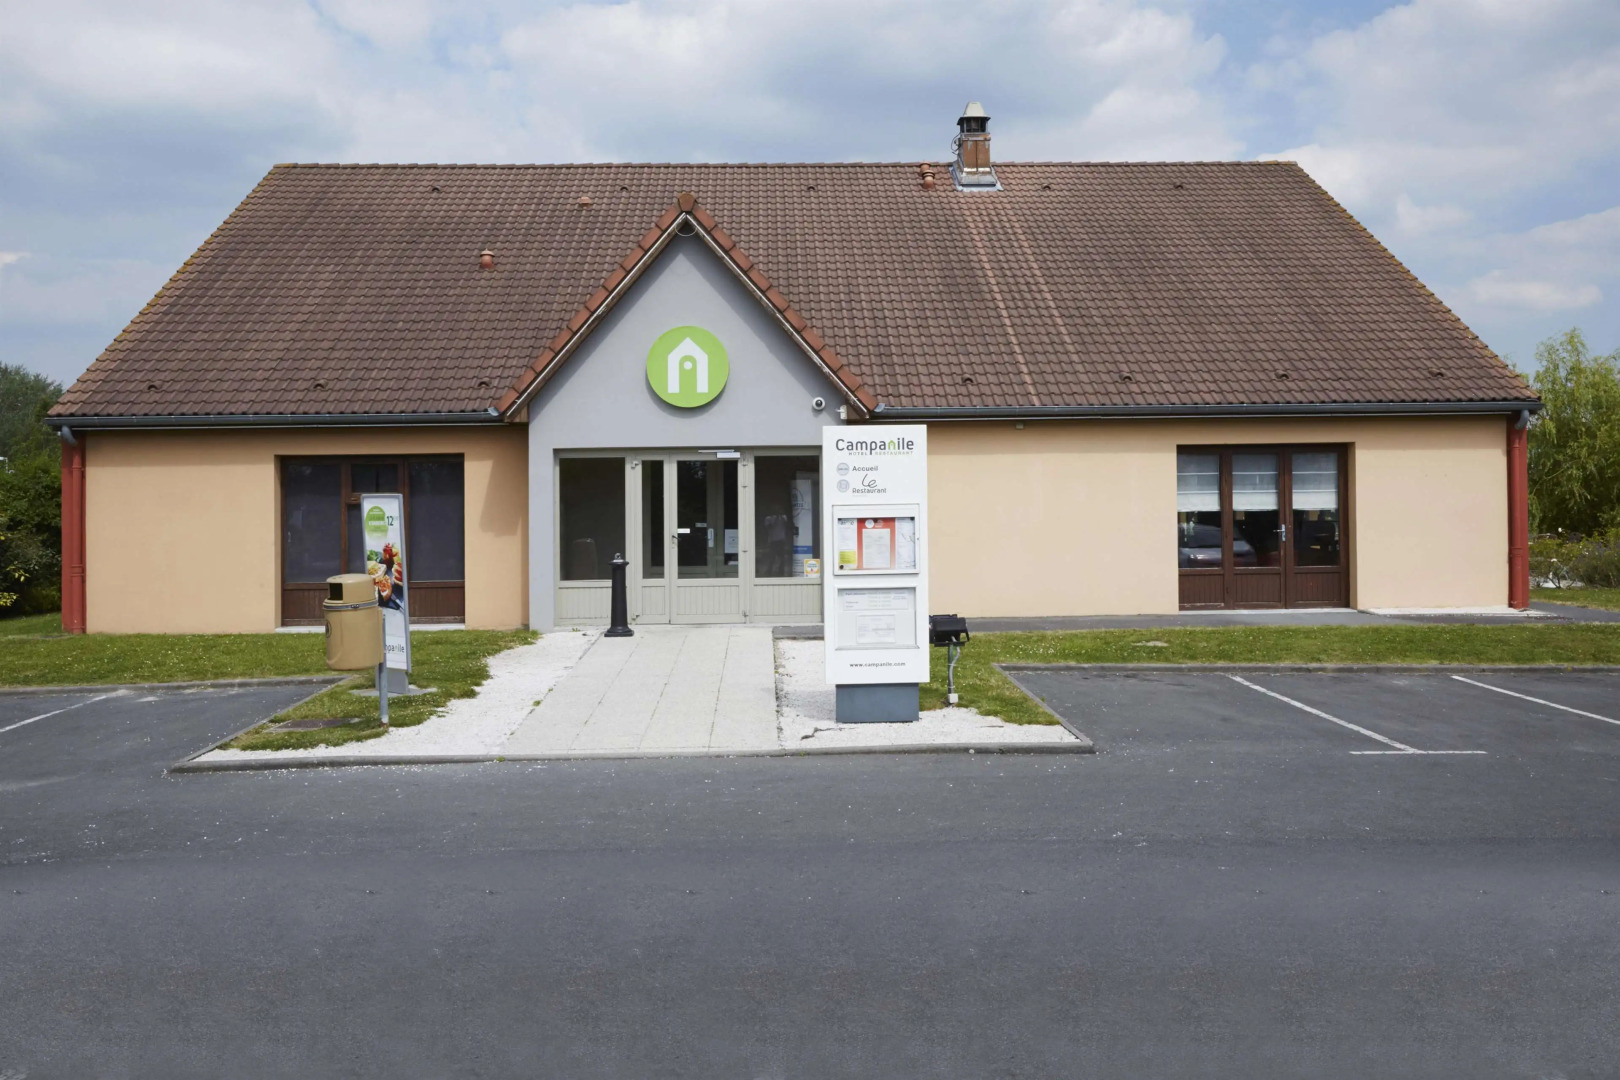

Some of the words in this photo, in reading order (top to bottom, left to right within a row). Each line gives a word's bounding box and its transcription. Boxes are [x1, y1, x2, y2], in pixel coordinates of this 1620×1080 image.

[836, 437, 914, 456] Campanile
[386, 515, 394, 526] 12
[385, 644, 405, 654] panile
